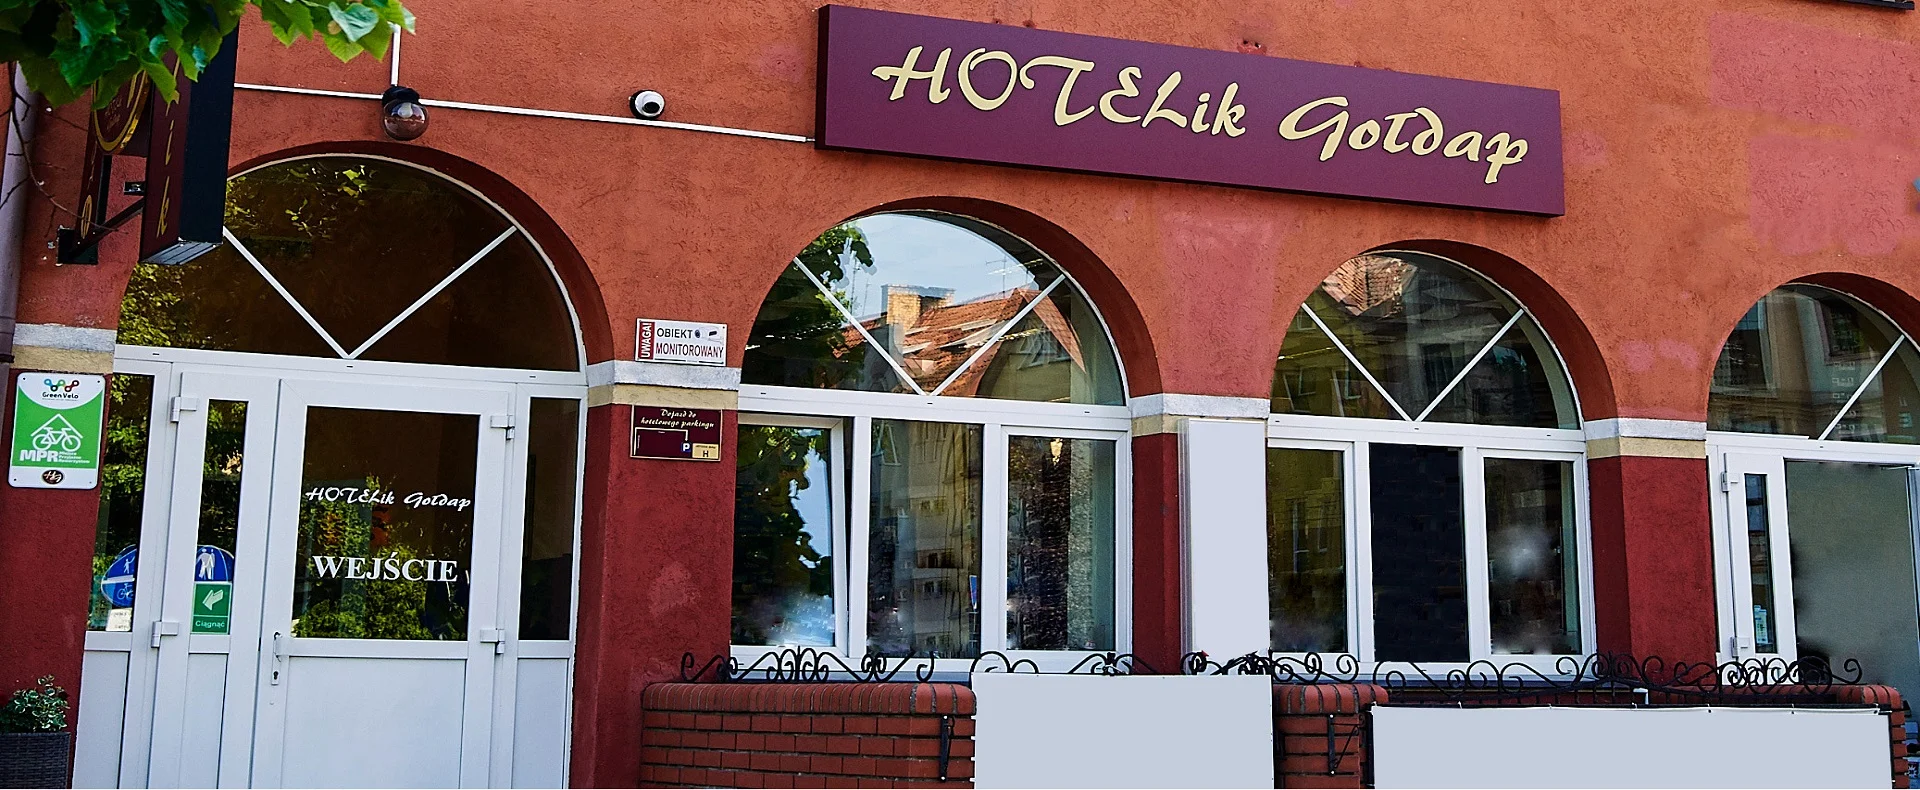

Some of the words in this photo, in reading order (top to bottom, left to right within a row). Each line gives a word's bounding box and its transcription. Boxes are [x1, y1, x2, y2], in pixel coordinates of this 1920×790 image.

[871, 45, 1247, 138] HOTELik
[640, 322, 652, 358] UWAGA!
[656, 327, 693, 339] OBIEKT
[655, 342, 724, 358] MONITOROWANY
[688, 410, 697, 418] do
[682, 442, 691, 452] P
[19, 449, 59, 462] MPR
[305, 487, 395, 505] HOTELik
[312, 552, 458, 582] WEJŚCIE
[195, 620, 225, 629] Ciągnąć
